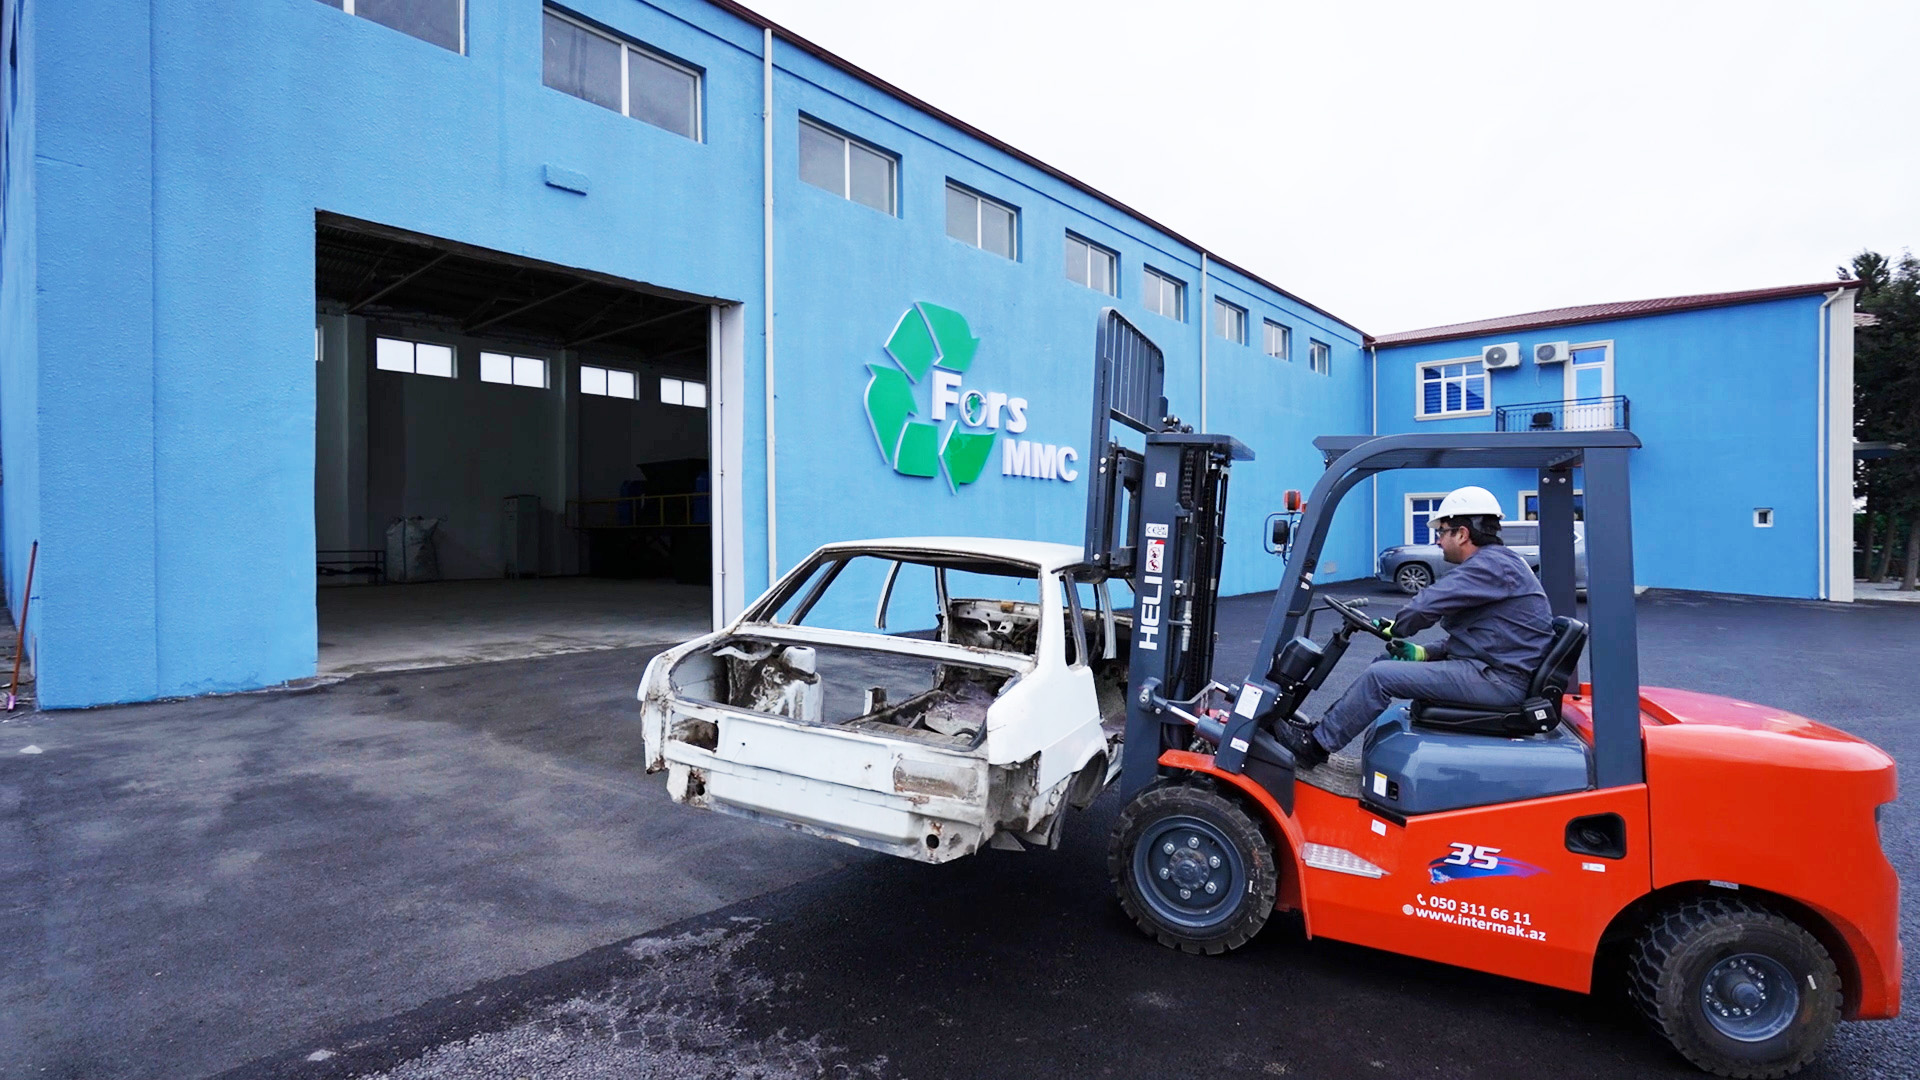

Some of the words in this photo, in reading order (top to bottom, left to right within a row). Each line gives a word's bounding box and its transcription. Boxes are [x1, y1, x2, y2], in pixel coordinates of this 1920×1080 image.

[931, 370, 1028, 434] Fors
[1002, 438, 1079, 482] MMC
[1138, 575, 1163, 650] HELI
[1443, 842, 1502, 870] 35
[1415, 906, 1547, 942] www.intermak.az
[1429, 896, 1457, 912] 050
[1460, 901, 1487, 917] 311
[1490, 907, 1509, 922] 66
[1513, 910, 1532, 926] 11
